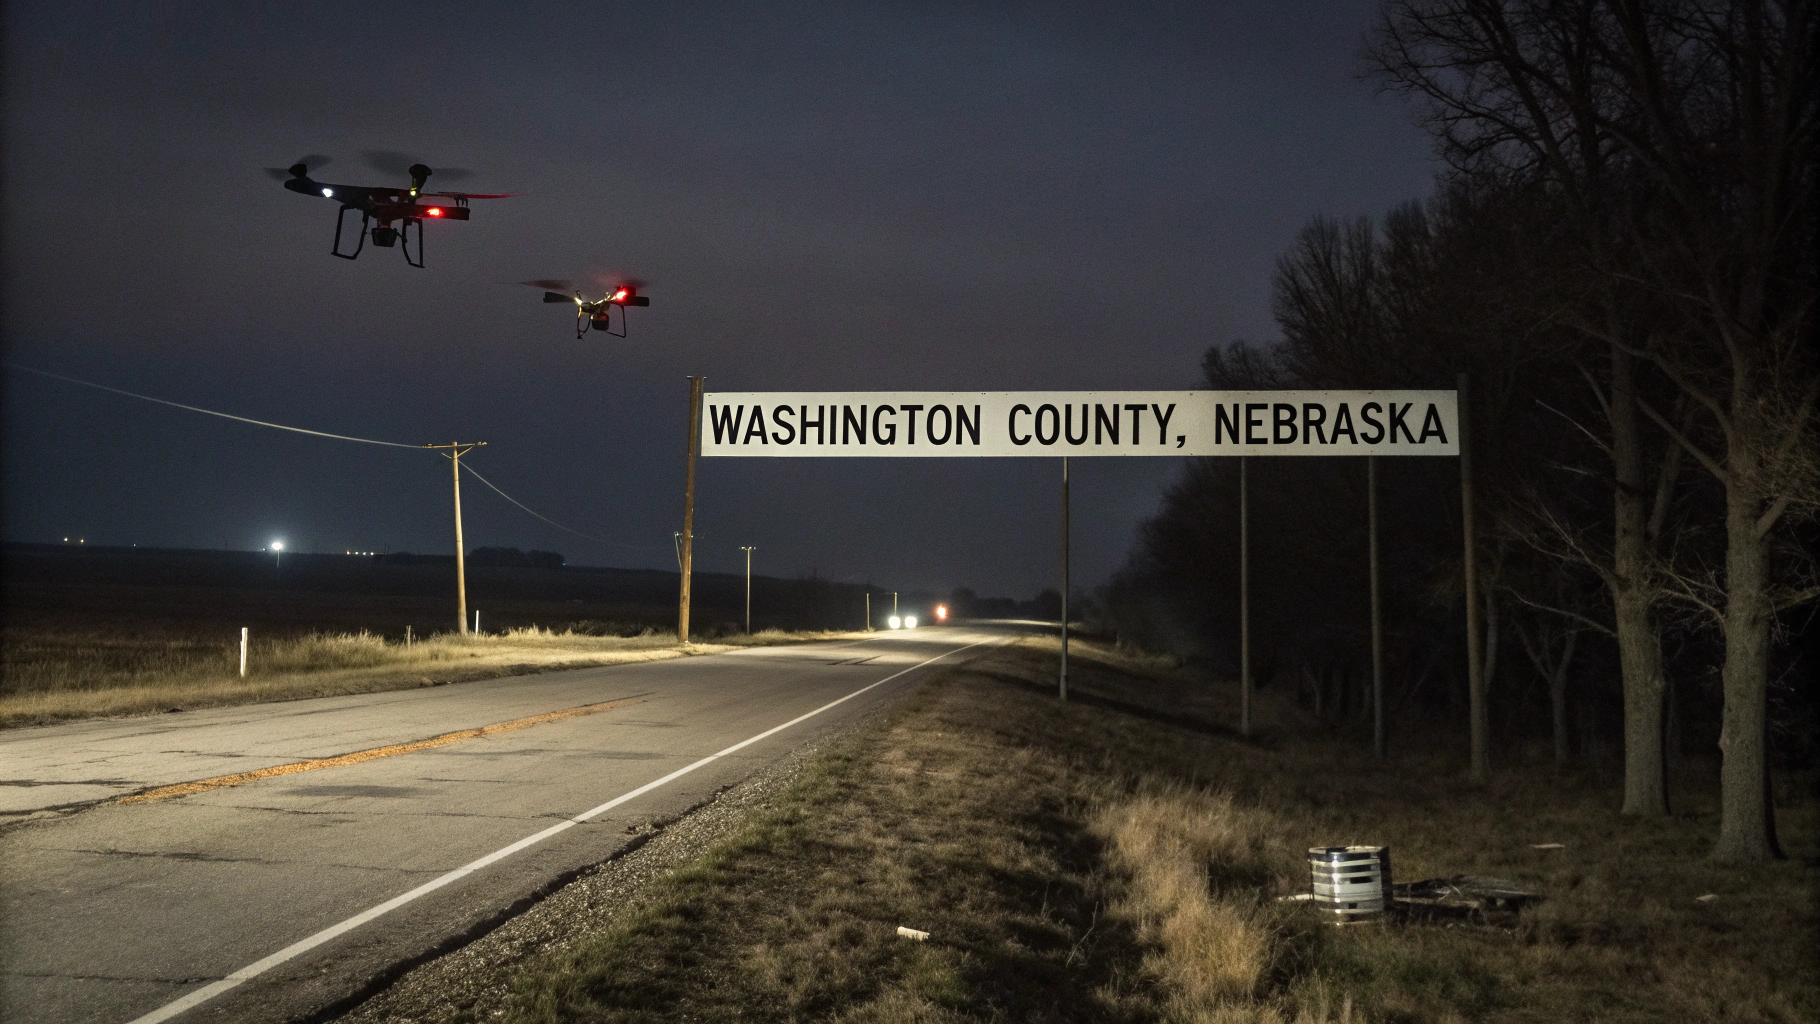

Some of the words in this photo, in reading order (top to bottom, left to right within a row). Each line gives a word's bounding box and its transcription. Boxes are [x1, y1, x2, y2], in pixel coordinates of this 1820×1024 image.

[709, 404, 981, 446] WASHINGTON
[1008, 403, 1187, 449] COUNTY,
[1214, 402, 1449, 445] NEBRASKA
